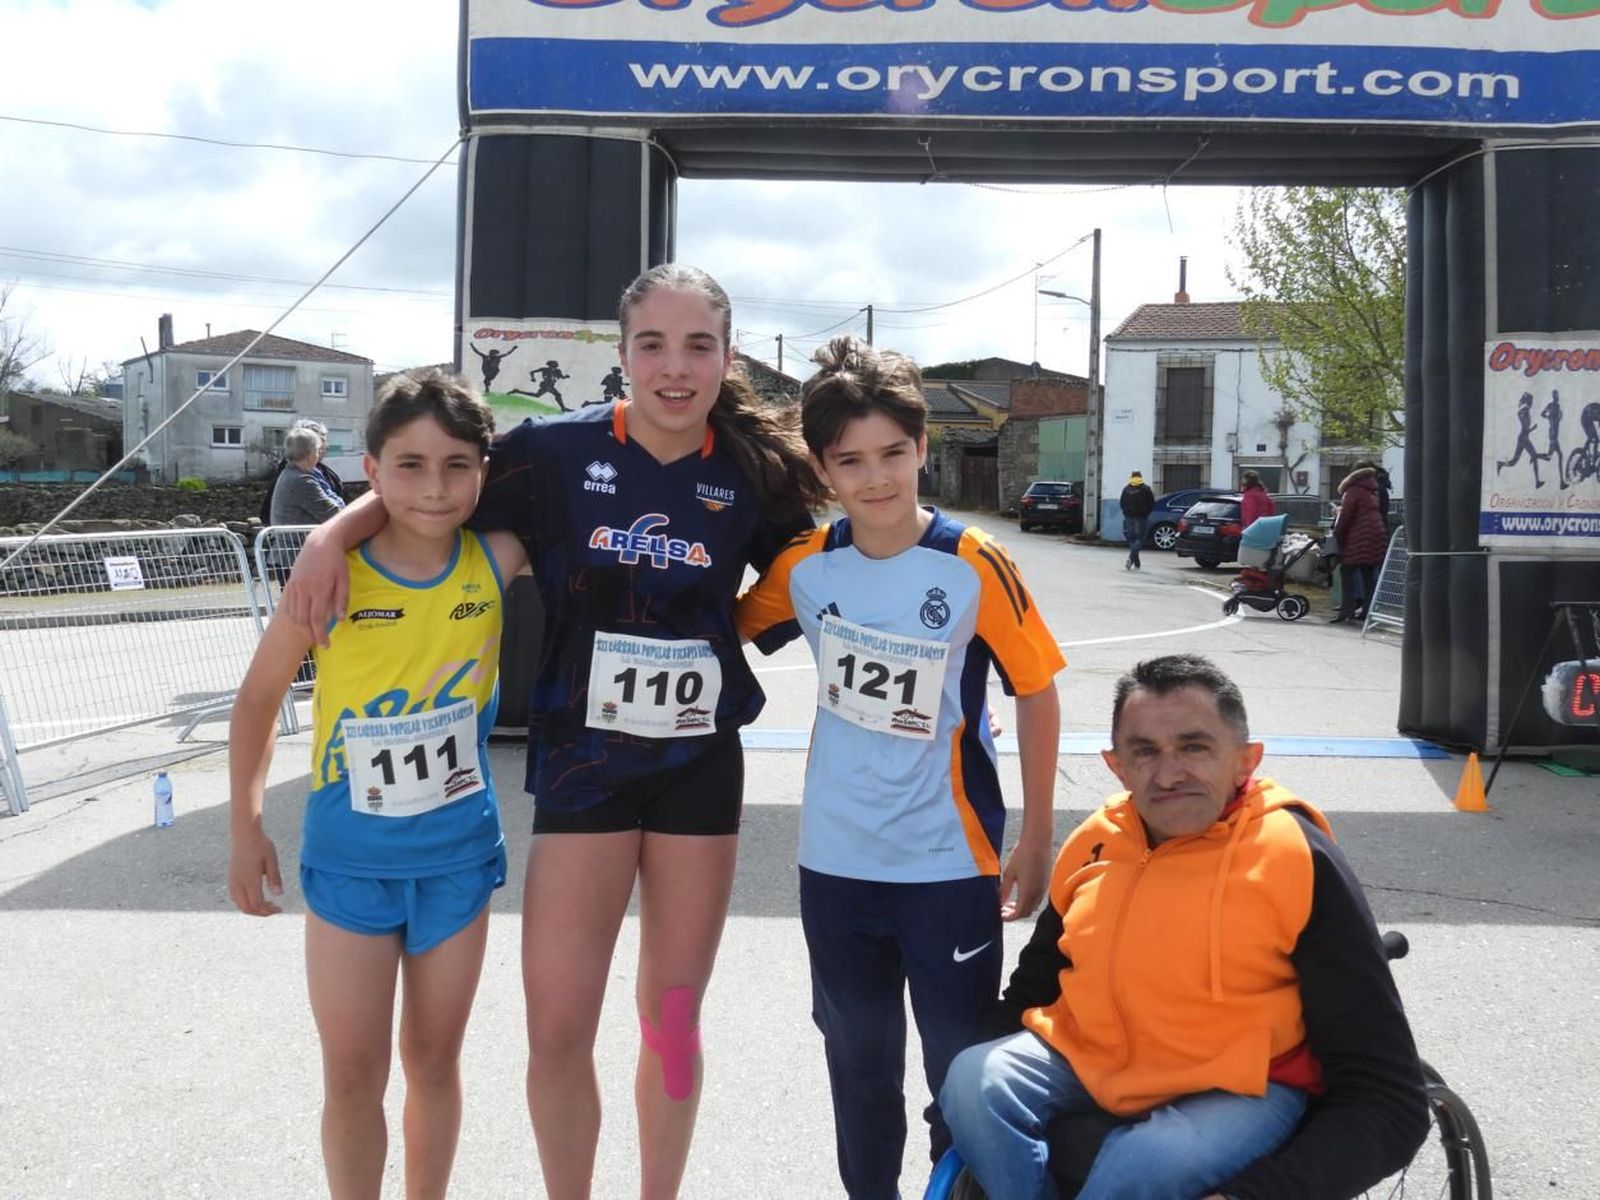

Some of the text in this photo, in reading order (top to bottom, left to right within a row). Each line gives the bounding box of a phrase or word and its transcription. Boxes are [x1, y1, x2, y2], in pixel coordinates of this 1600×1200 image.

[629, 61, 1520, 101] www.orycronsport.com
[696, 482, 736, 501] VILLARES
[1502, 516, 1600, 534] www.orycron
[860, 632, 888, 651] POPULAR
[641, 644, 671, 660] POPULAR
[614, 667, 704, 707] 110
[837, 653, 918, 705] 121
[389, 719, 420, 736] POPULAR
[371, 735, 458, 785] 111
